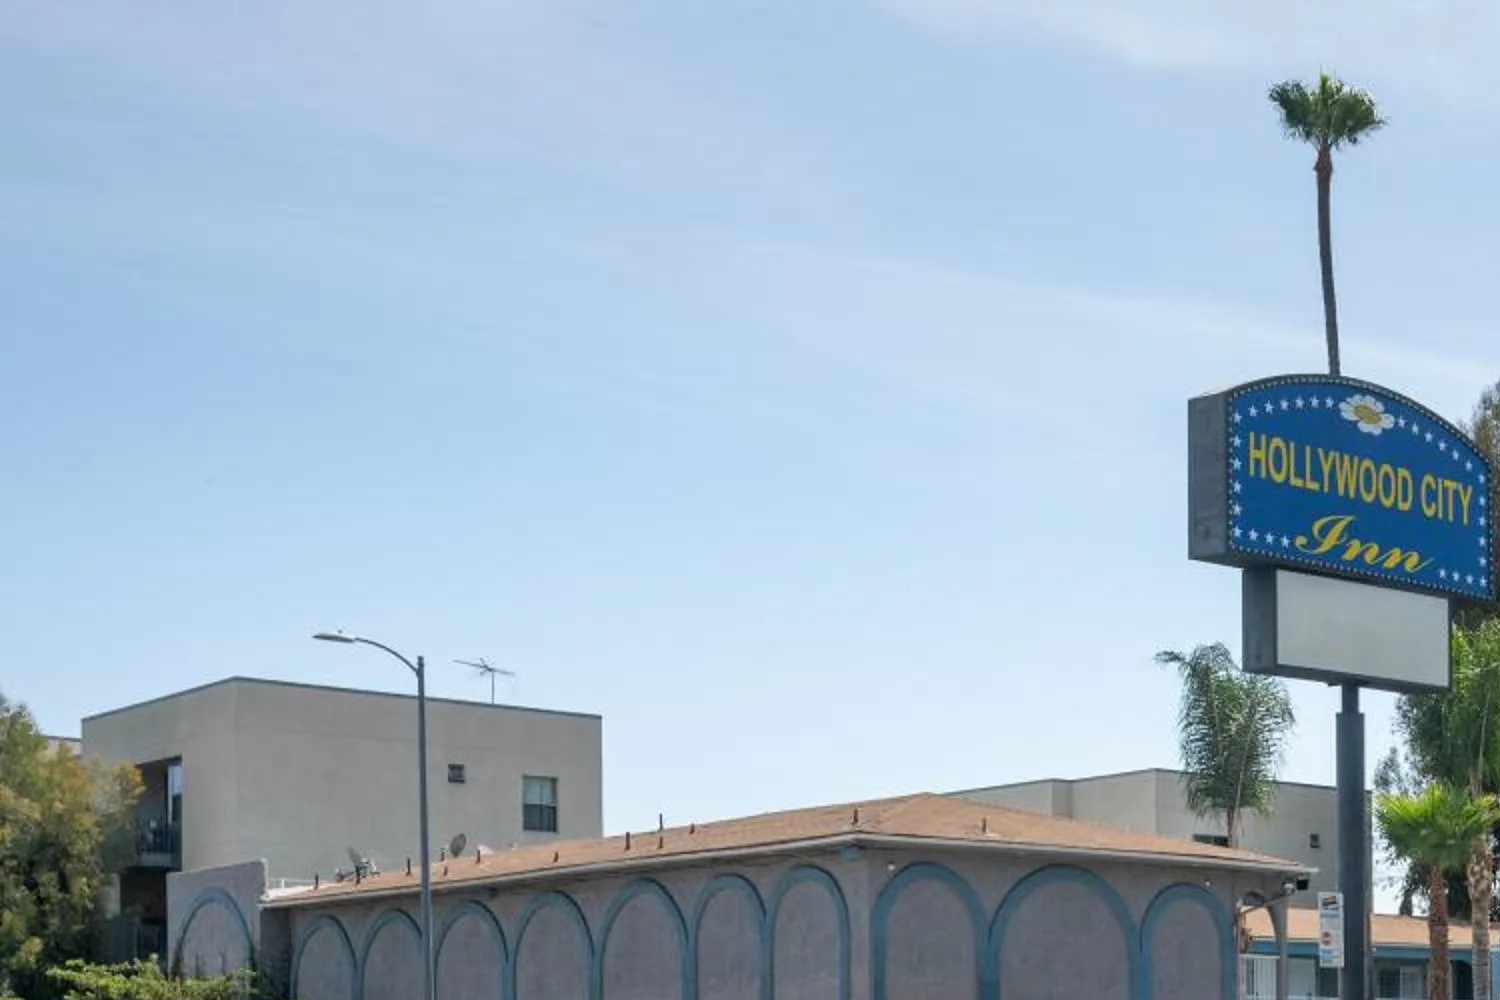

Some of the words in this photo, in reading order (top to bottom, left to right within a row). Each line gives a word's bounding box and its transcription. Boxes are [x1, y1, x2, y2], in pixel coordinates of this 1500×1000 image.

[1249, 432, 1413, 511] HOLLYWOOD
[1421, 474, 1472, 525] CITY
[1295, 515, 1433, 572] Inn
